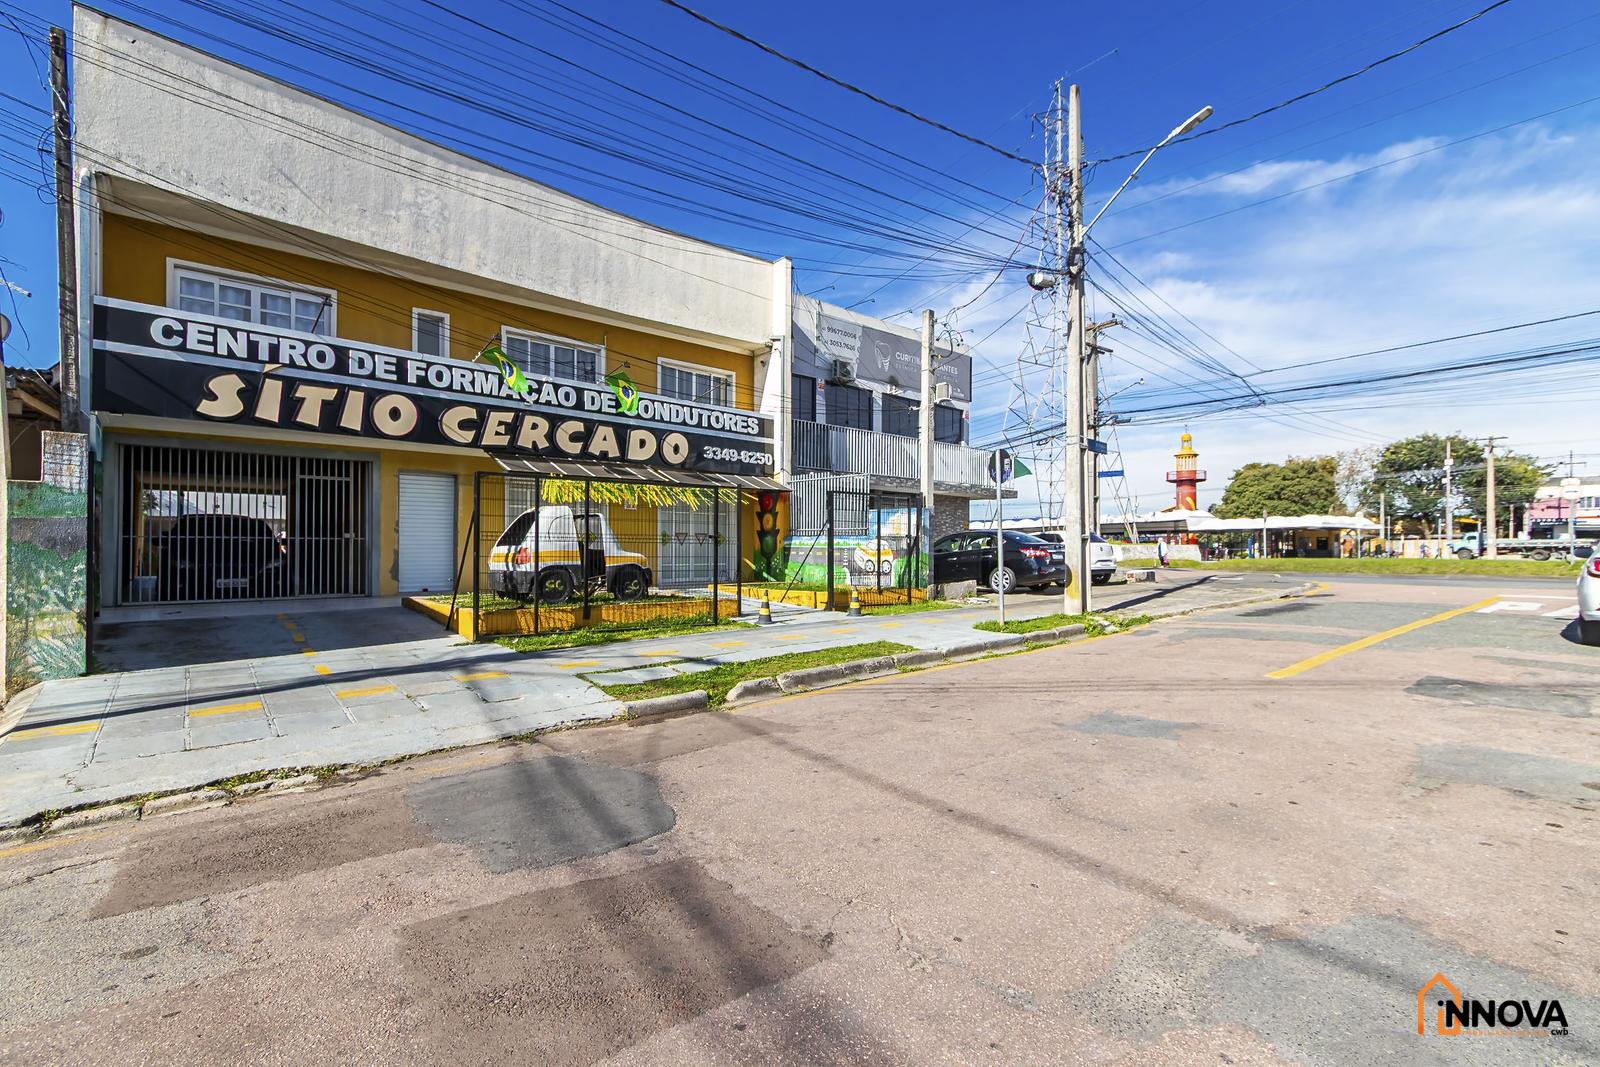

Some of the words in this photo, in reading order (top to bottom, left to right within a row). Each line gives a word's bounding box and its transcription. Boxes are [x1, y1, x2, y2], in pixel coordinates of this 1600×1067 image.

[150, 317, 336, 370] CENTRO
[349, 350, 398, 379] DE
[584, 389, 617, 413] DE
[624, 398, 759, 434] ONDUTORES
[196, 364, 417, 437] SÍTIO
[441, 406, 689, 464] CERCADO
[703, 446, 773, 465] 3349-8250
